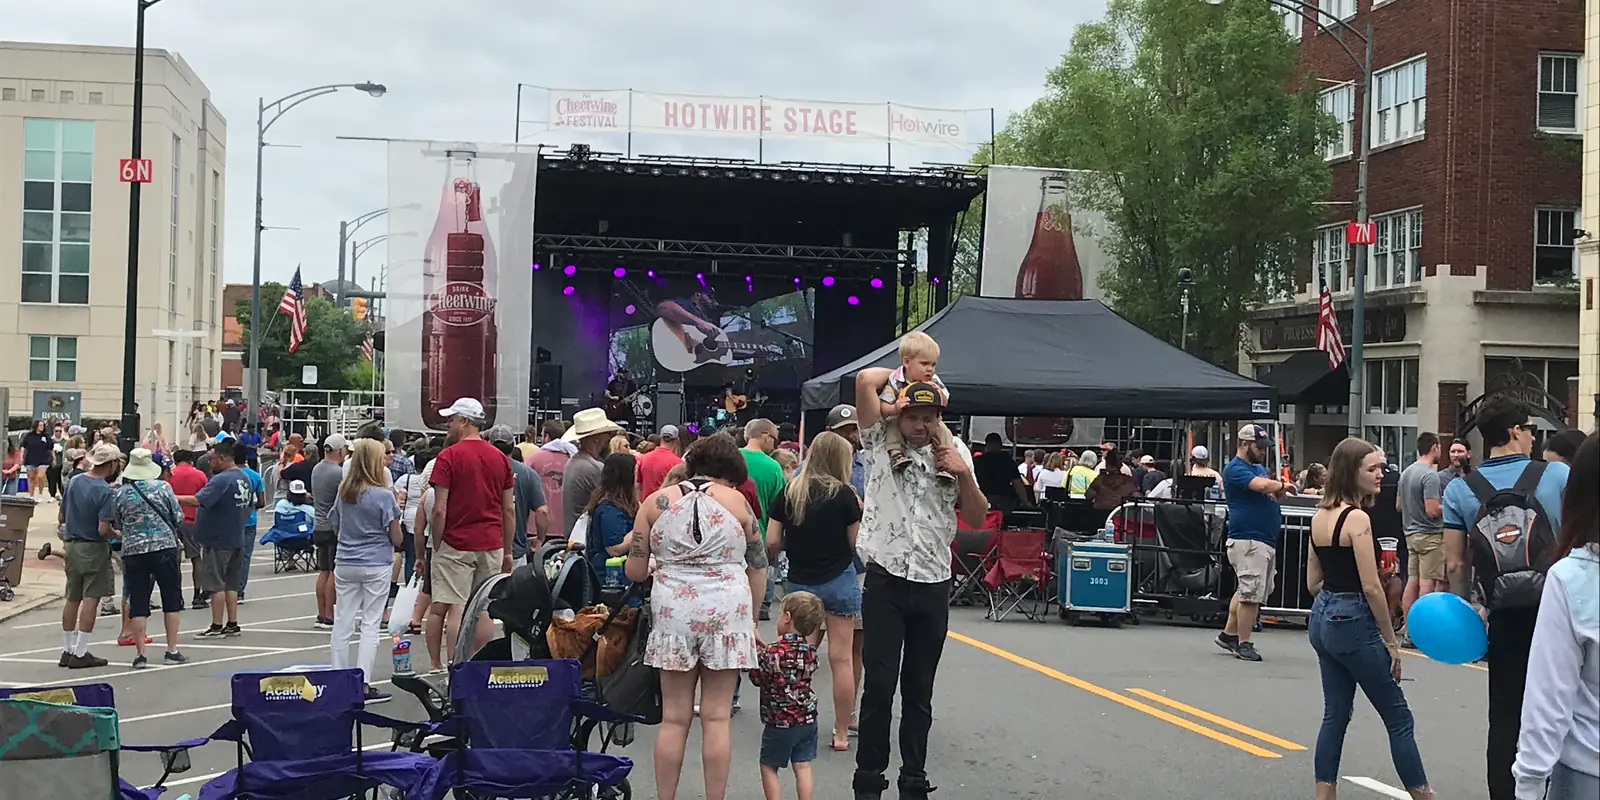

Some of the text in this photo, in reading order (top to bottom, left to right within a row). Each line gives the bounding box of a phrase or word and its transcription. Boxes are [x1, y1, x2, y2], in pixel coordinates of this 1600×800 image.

[556, 98, 618, 116] Cheerwine
[566, 115, 618, 128] FESTIVAL
[664, 101, 857, 136] HOTWIRE STAGE
[890, 113, 960, 137] Hotwire
[122, 160, 149, 181] 6N
[1355, 223, 1371, 243] 7N
[427, 292, 495, 313] Cheerwine
[487, 673, 546, 687] Academy
[265, 683, 325, 698] Acadey
